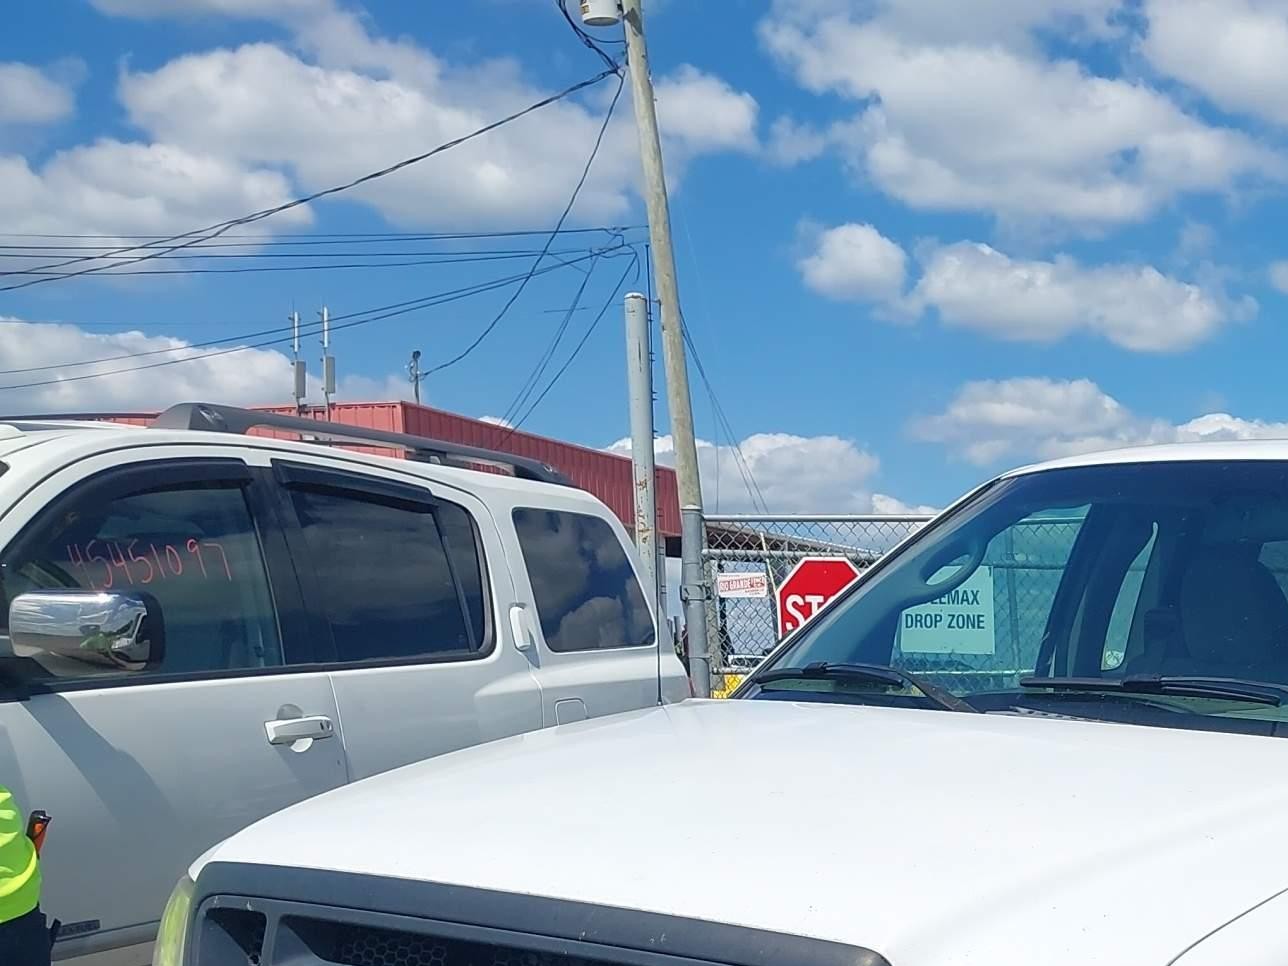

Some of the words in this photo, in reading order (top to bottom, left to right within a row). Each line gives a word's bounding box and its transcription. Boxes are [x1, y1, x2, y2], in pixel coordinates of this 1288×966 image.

[66, 538, 232, 589] 45451097
[904, 613, 943, 630] DROP
[947, 613, 985, 630] ZONE
